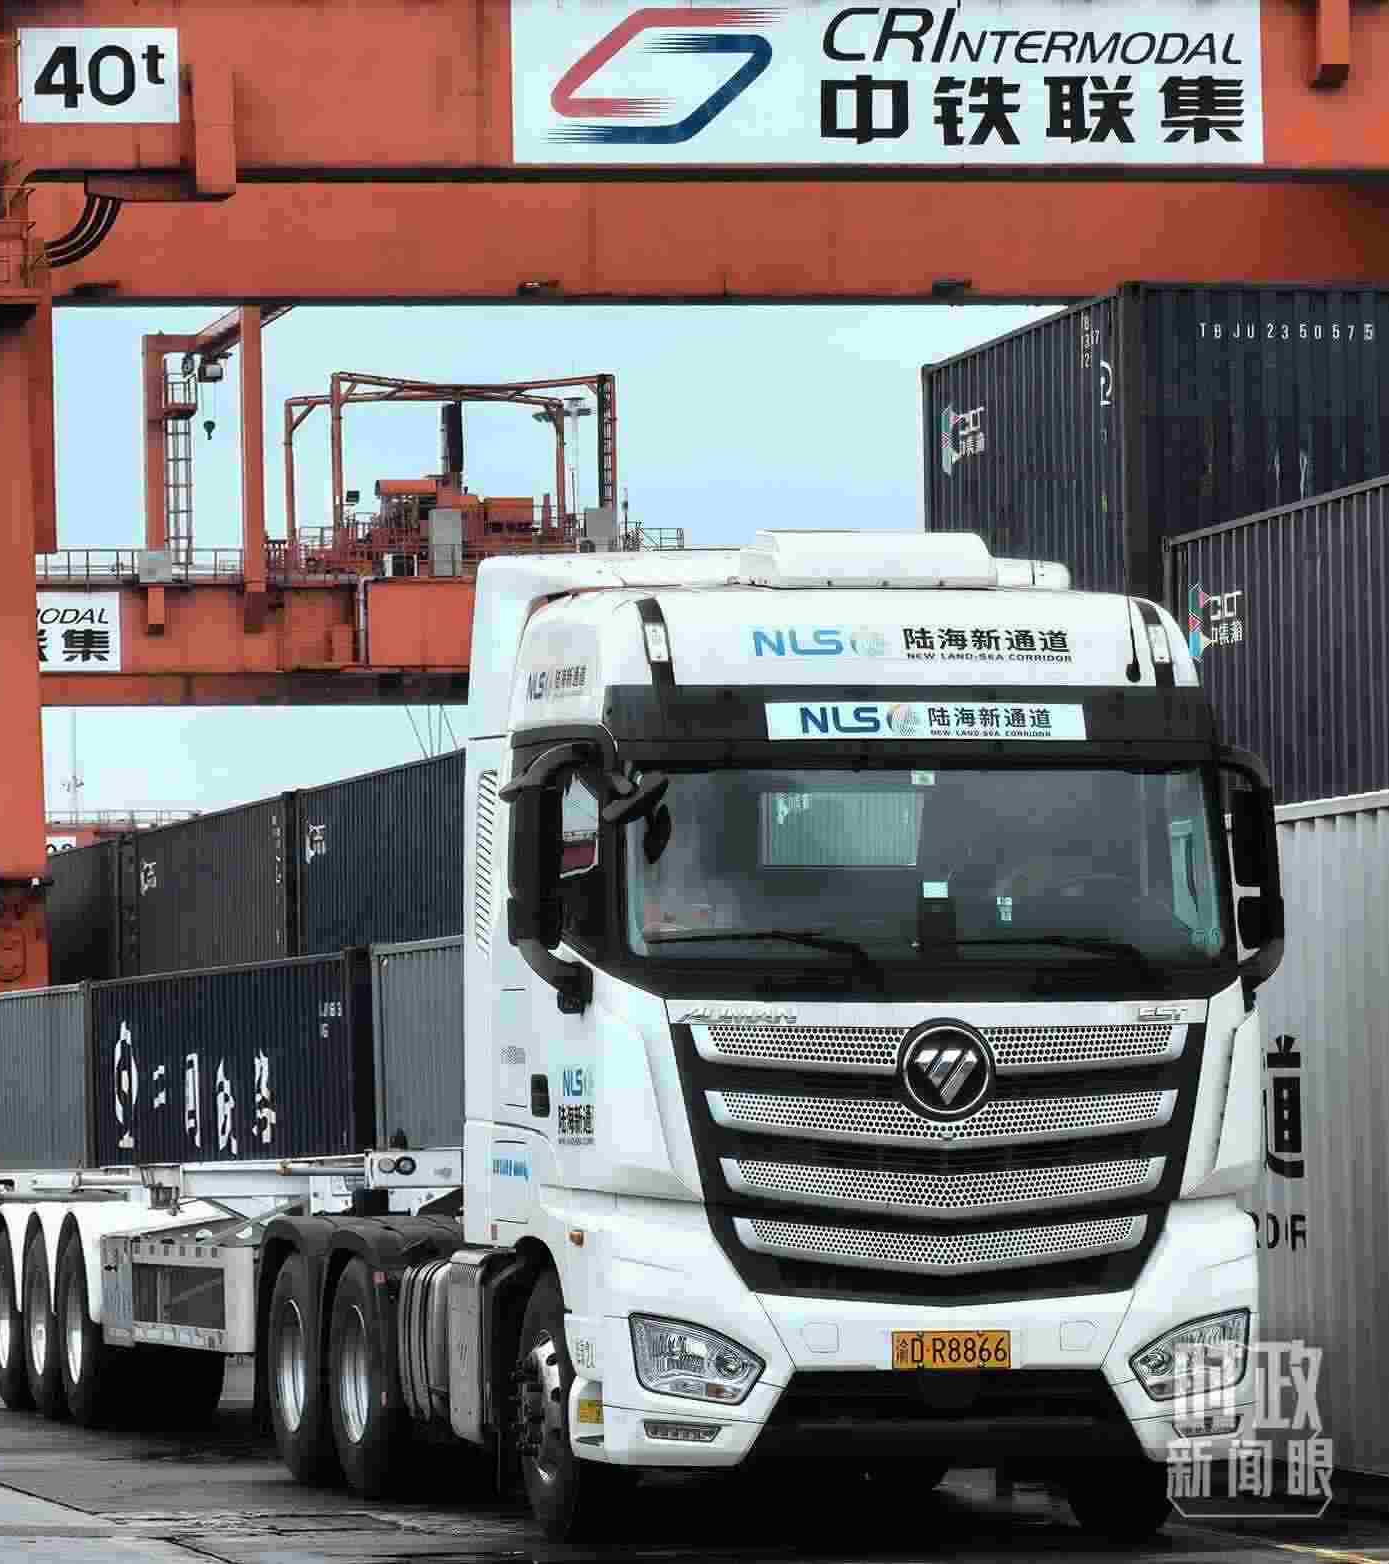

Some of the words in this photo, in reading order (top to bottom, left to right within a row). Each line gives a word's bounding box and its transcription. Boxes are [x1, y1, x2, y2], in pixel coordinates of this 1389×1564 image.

[34, 44, 165, 108] 40t
[821, 75, 1245, 146] 中铁联集
[753, 629, 843, 656] NLS
[903, 627, 1069, 653] 陆海新通道
[799, 706, 880, 733] NLS
[927, 707, 1052, 728] 陆海新通道
